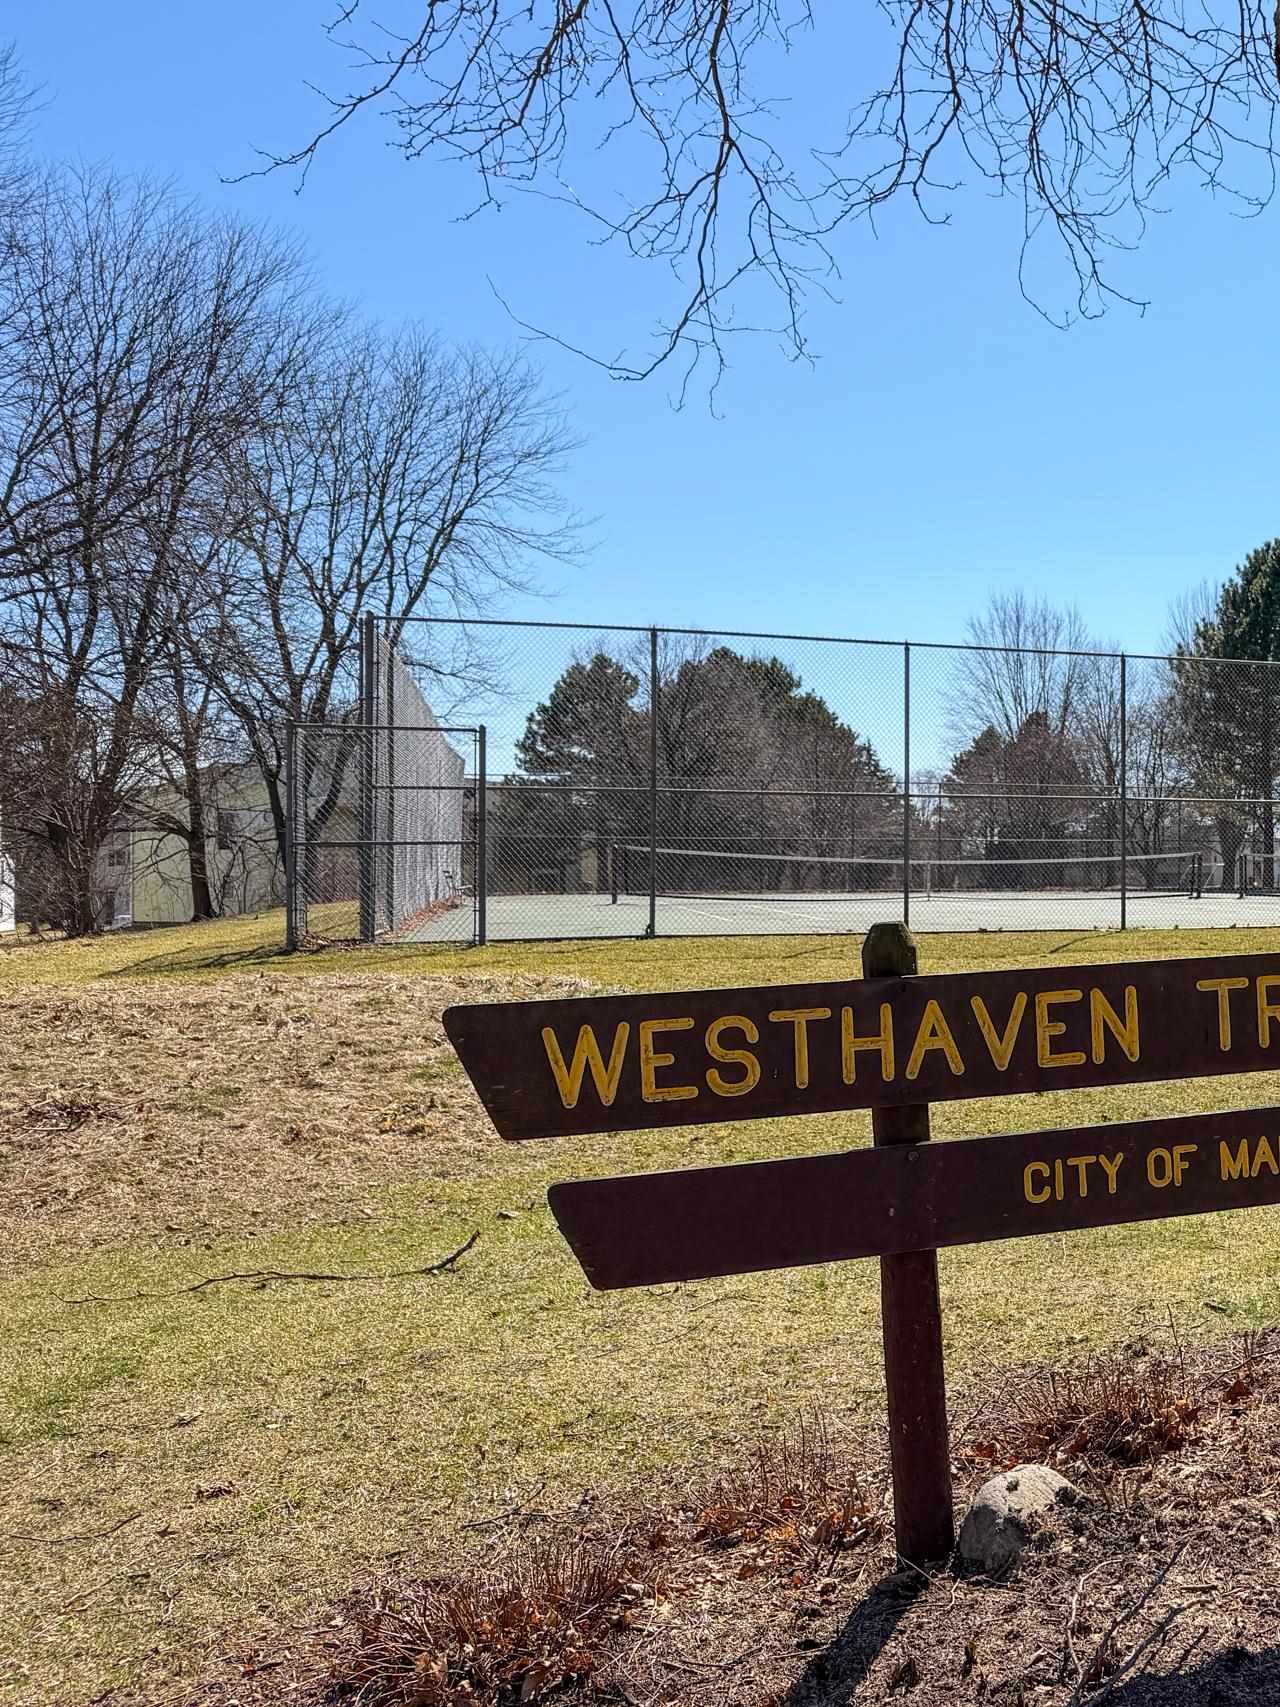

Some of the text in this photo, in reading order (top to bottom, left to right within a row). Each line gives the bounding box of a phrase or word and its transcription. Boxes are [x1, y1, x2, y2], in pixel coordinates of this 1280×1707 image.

[541, 985, 1140, 1108] WESTHAVEN
[1022, 1151, 1125, 1204] CITY
[1145, 1143, 1199, 1188] OF
